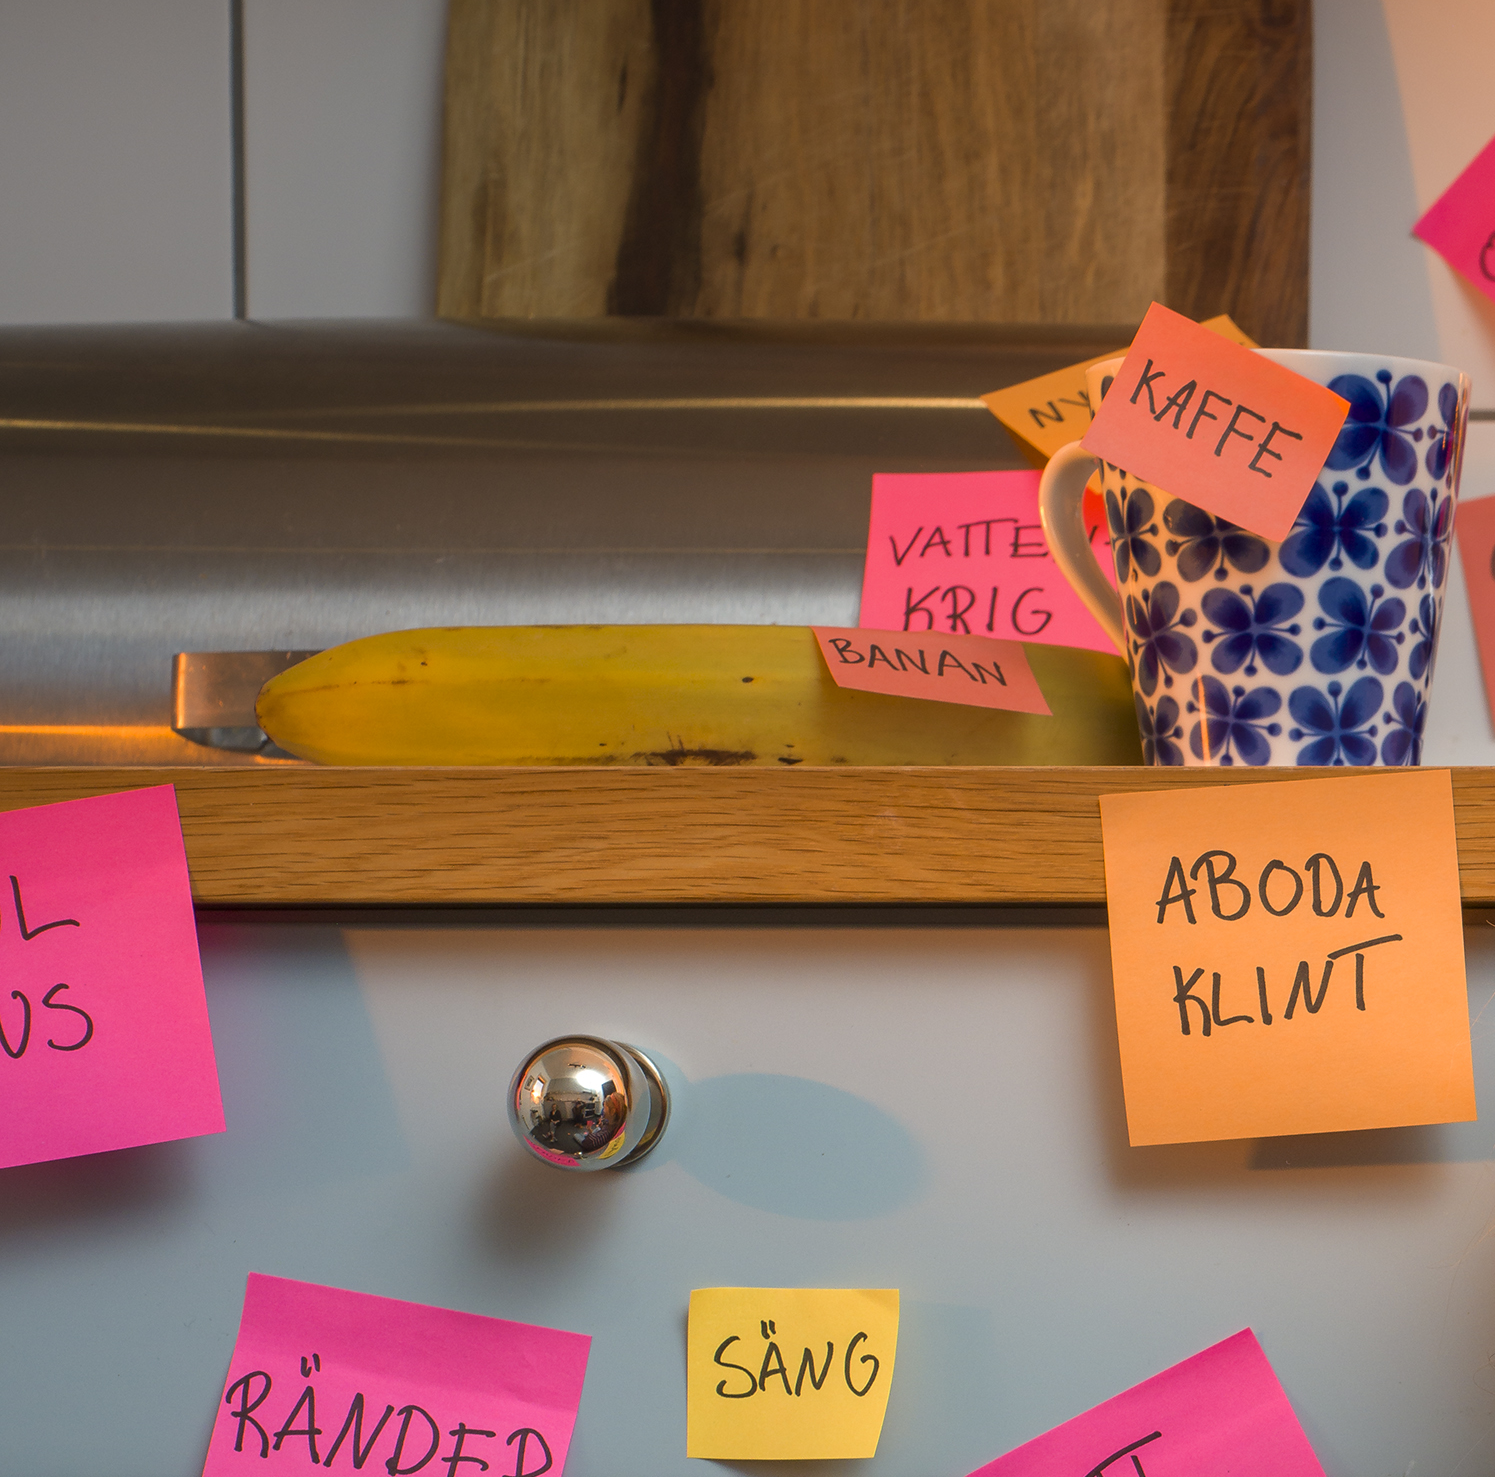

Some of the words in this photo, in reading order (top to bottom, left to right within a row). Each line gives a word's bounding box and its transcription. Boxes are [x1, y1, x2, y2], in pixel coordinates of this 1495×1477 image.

[1130, 359, 1303, 478] KAFFE
[903, 585, 1053, 636] KRIG
[828, 637, 1008, 687] BANAN
[1156, 850, 1385, 924] ABODA
[1173, 934, 1403, 1037] KLINT
[714, 1320, 879, 1398] SÄNG
